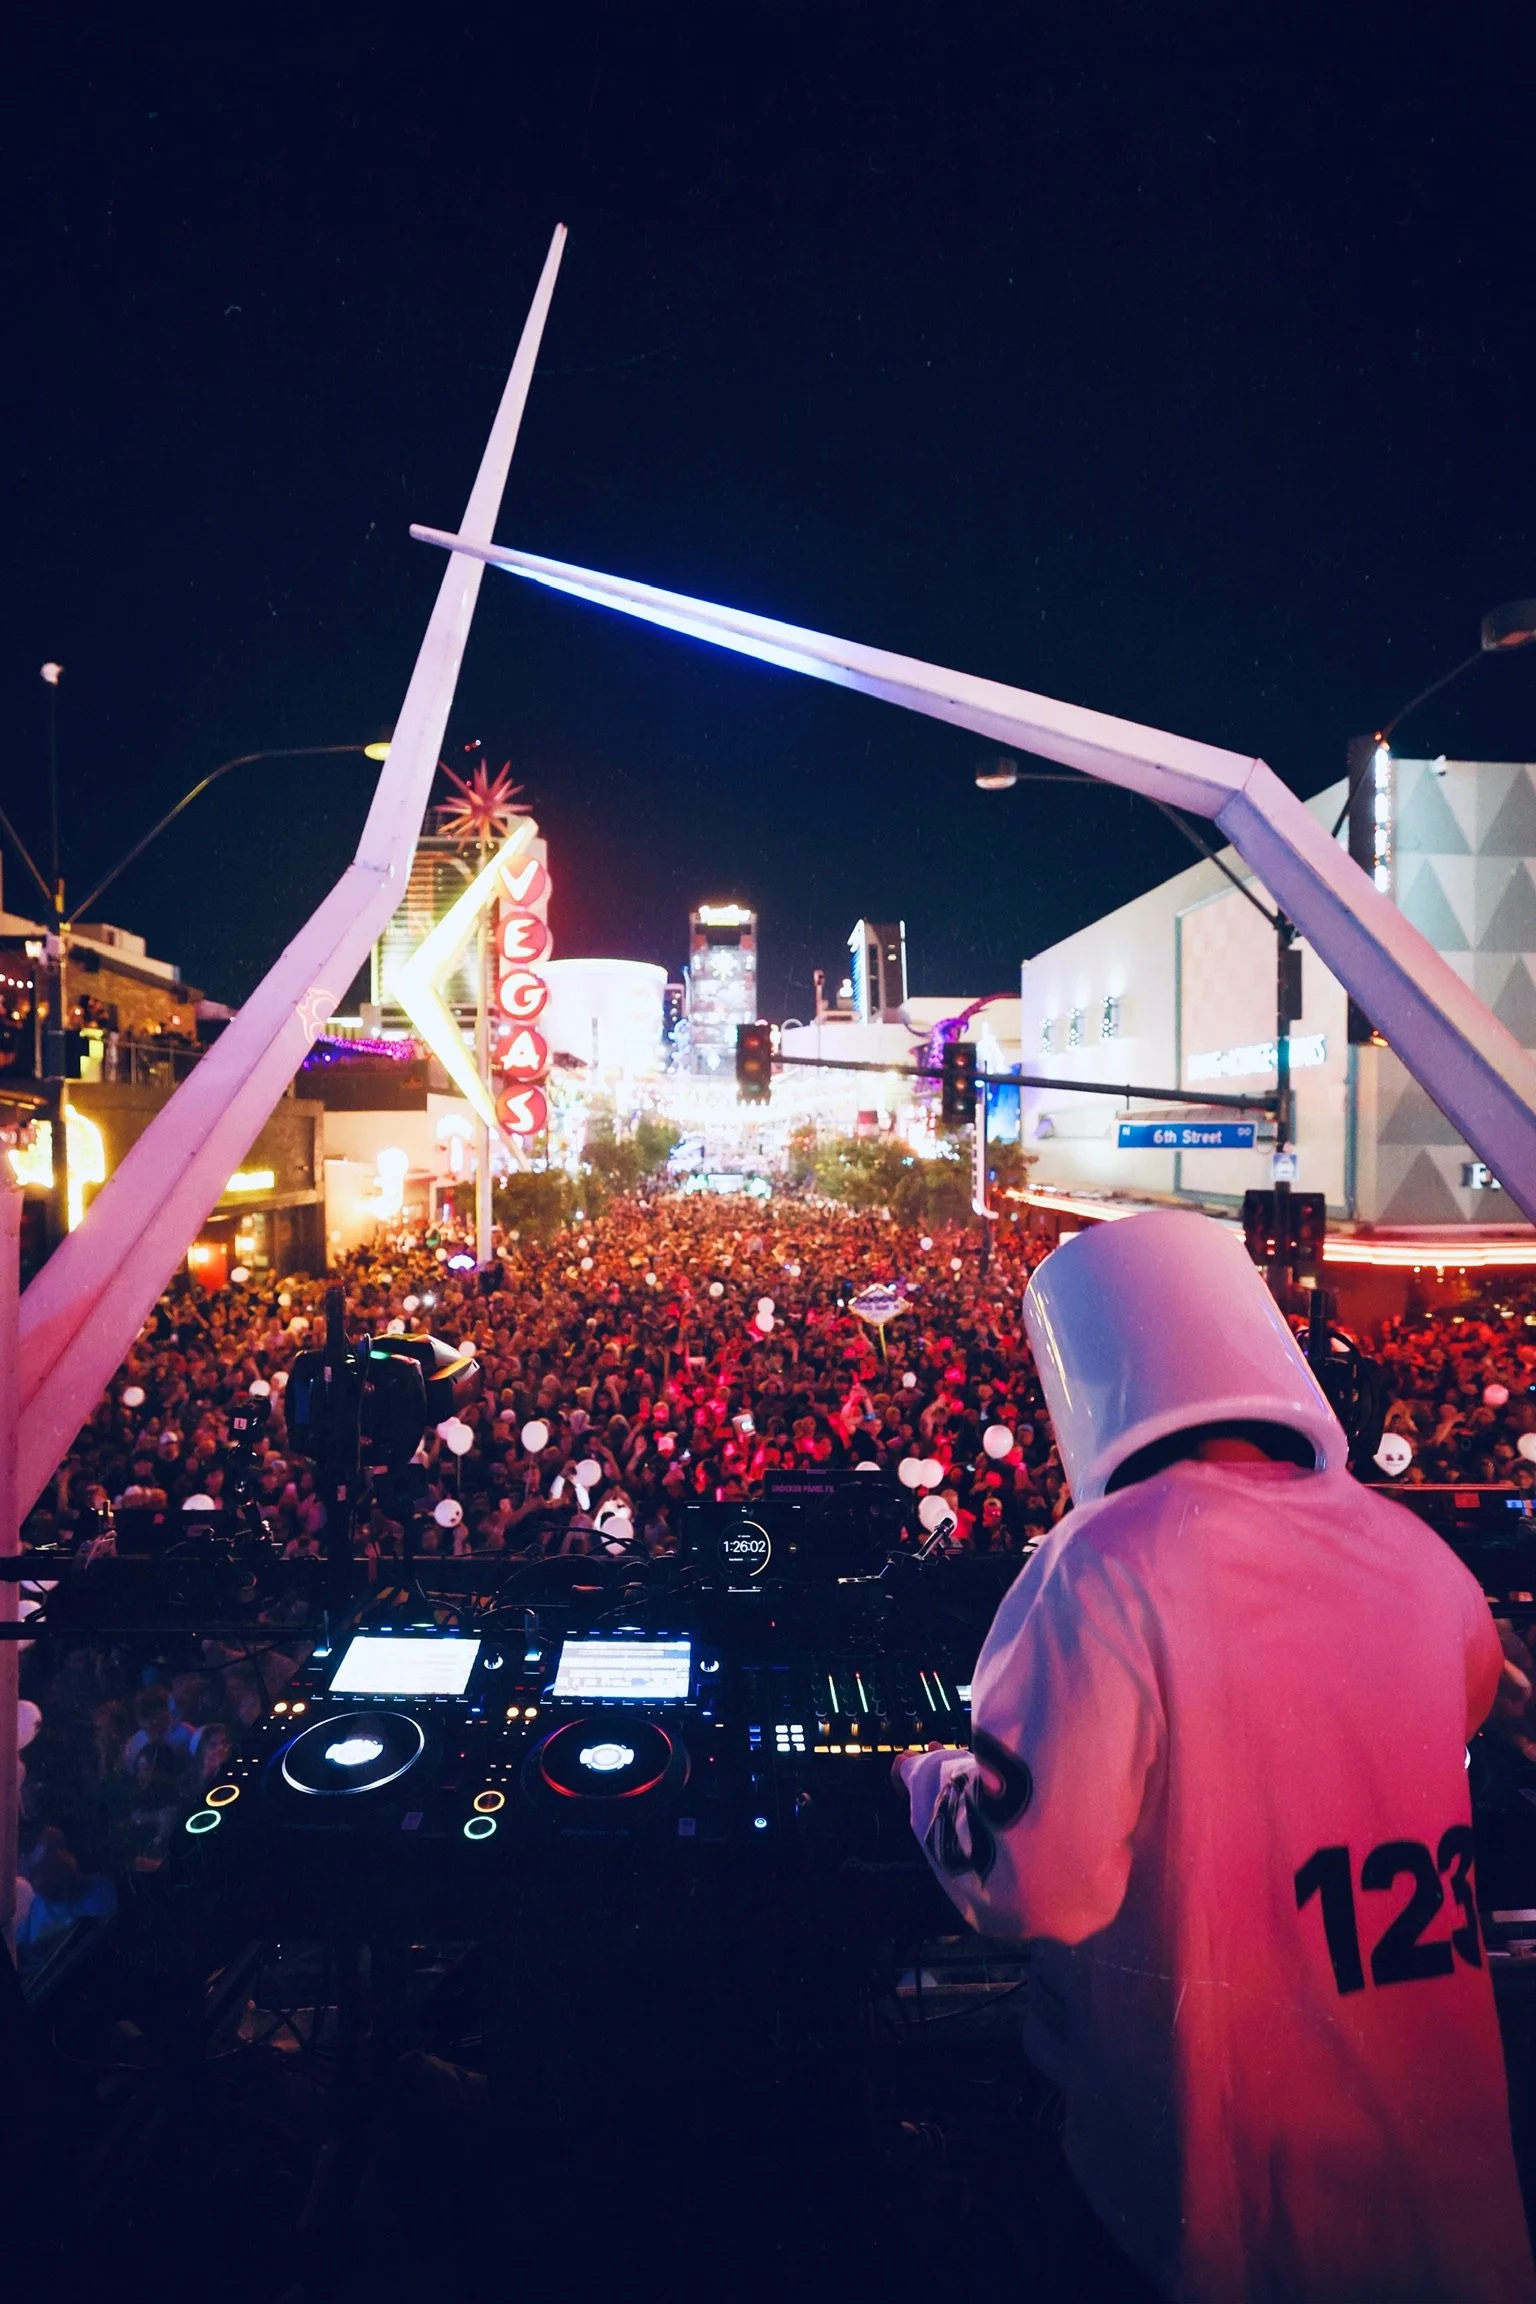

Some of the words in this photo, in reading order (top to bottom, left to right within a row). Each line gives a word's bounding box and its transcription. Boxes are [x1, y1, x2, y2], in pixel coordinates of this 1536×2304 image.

[499, 859, 545, 1132] VEGAS
[1153, 1130, 1177, 1144] 6th
[1182, 1129, 1222, 1144] Street
[723, 1540, 766, 1553] 1:26:02
[1295, 1825, 1482, 1995] 123
